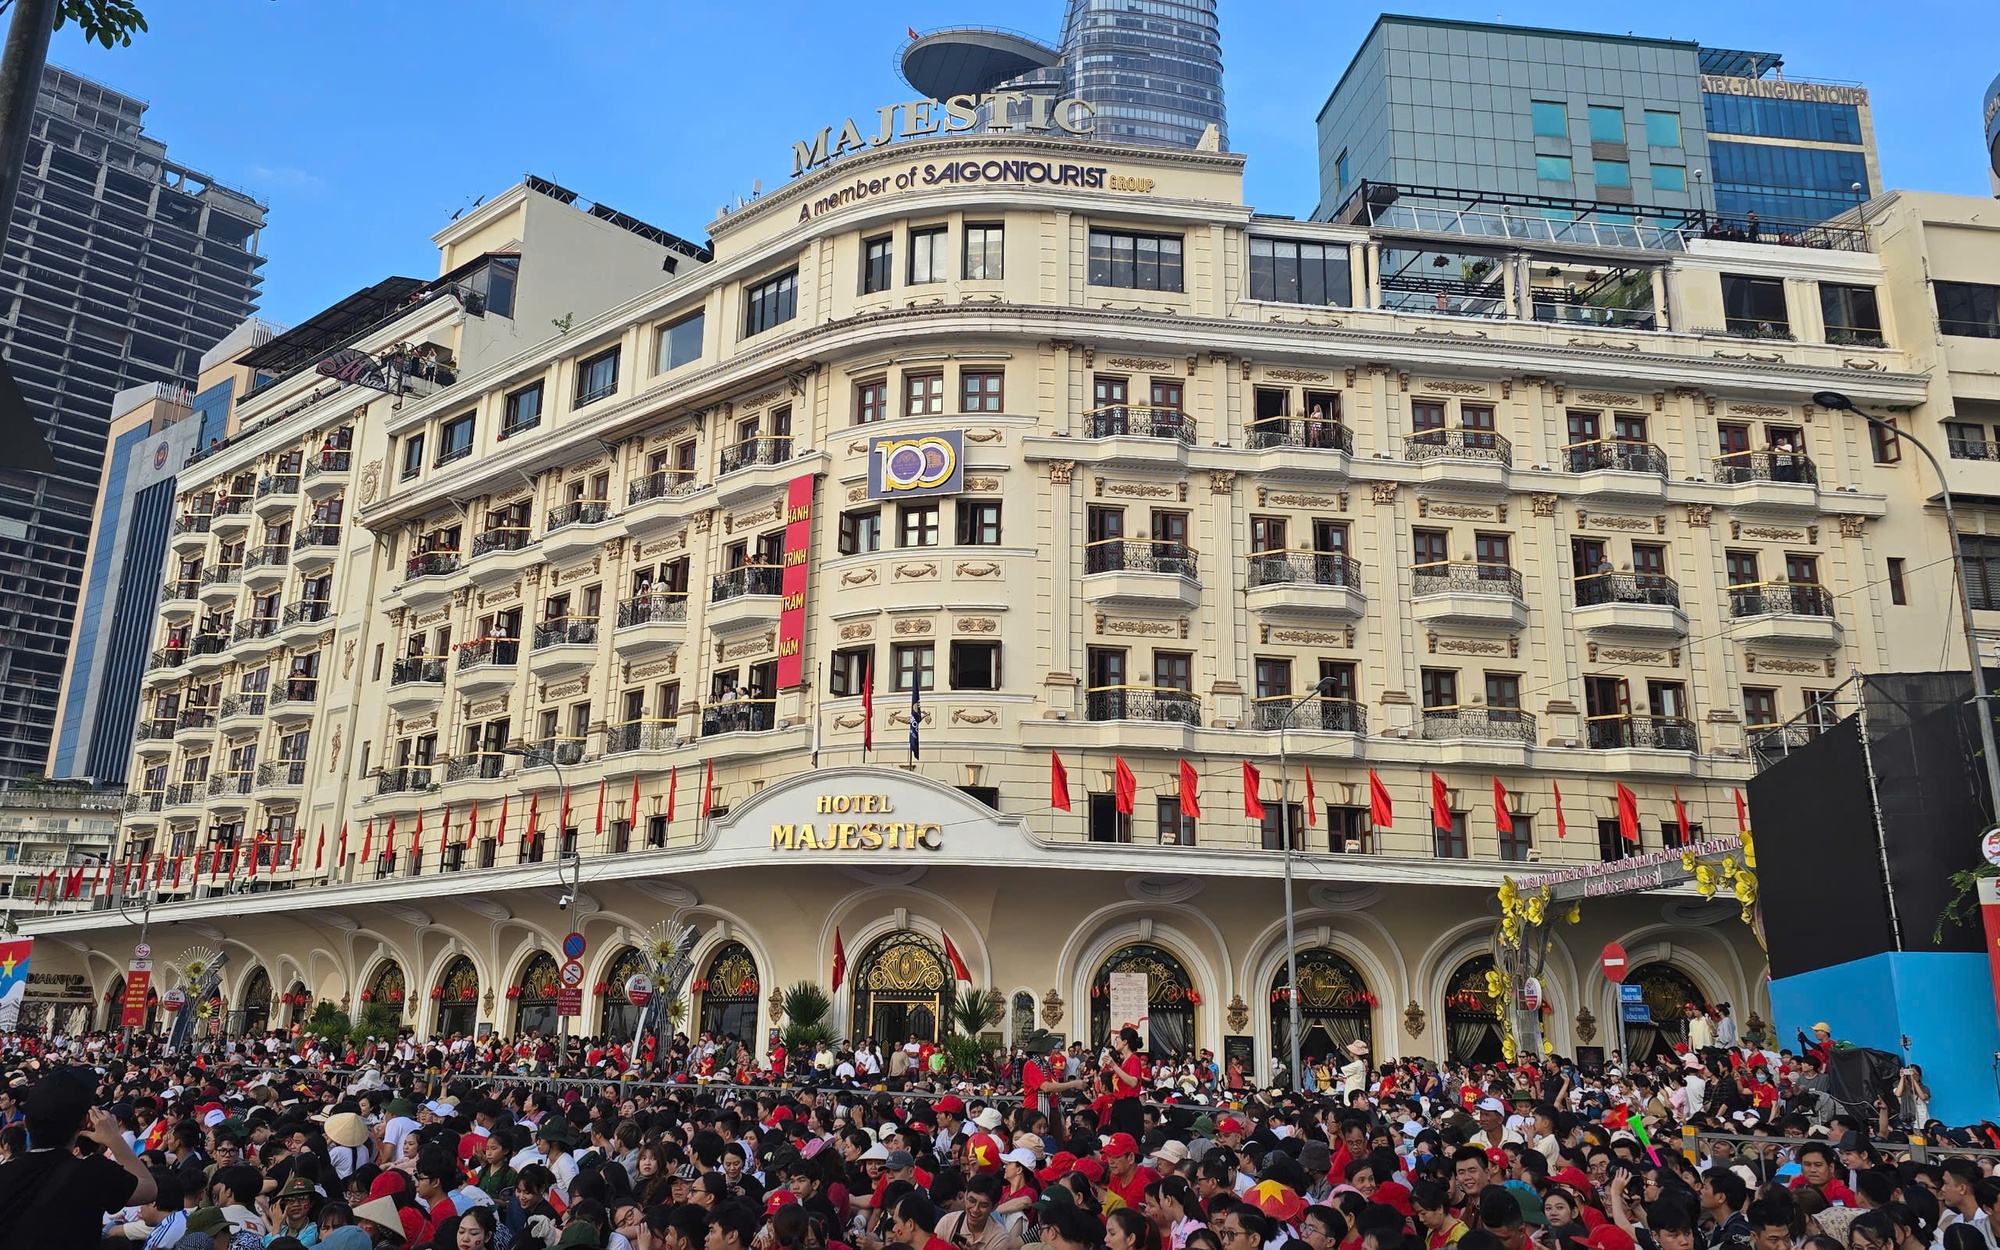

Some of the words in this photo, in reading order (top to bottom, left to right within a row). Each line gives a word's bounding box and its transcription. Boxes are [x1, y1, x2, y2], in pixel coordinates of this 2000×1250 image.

[1821, 86, 1868, 106] TOWER
[790, 91, 1097, 178] MAJESTIC
[799, 203, 811, 223] A
[814, 177, 890, 217] member
[895, 166, 918, 190] of
[922, 160, 1106, 189] SAIGONTOURIST
[1108, 174, 1155, 192] GROUP
[874, 437, 956, 493] 100
[787, 504, 810, 525] HÀNH
[783, 547, 807, 568] TRÌNH
[780, 590, 804, 612] TRĂM
[779, 636, 799, 658] NĂM
[816, 794, 894, 814] HOTEL
[769, 822, 943, 851] MAJESTIC
